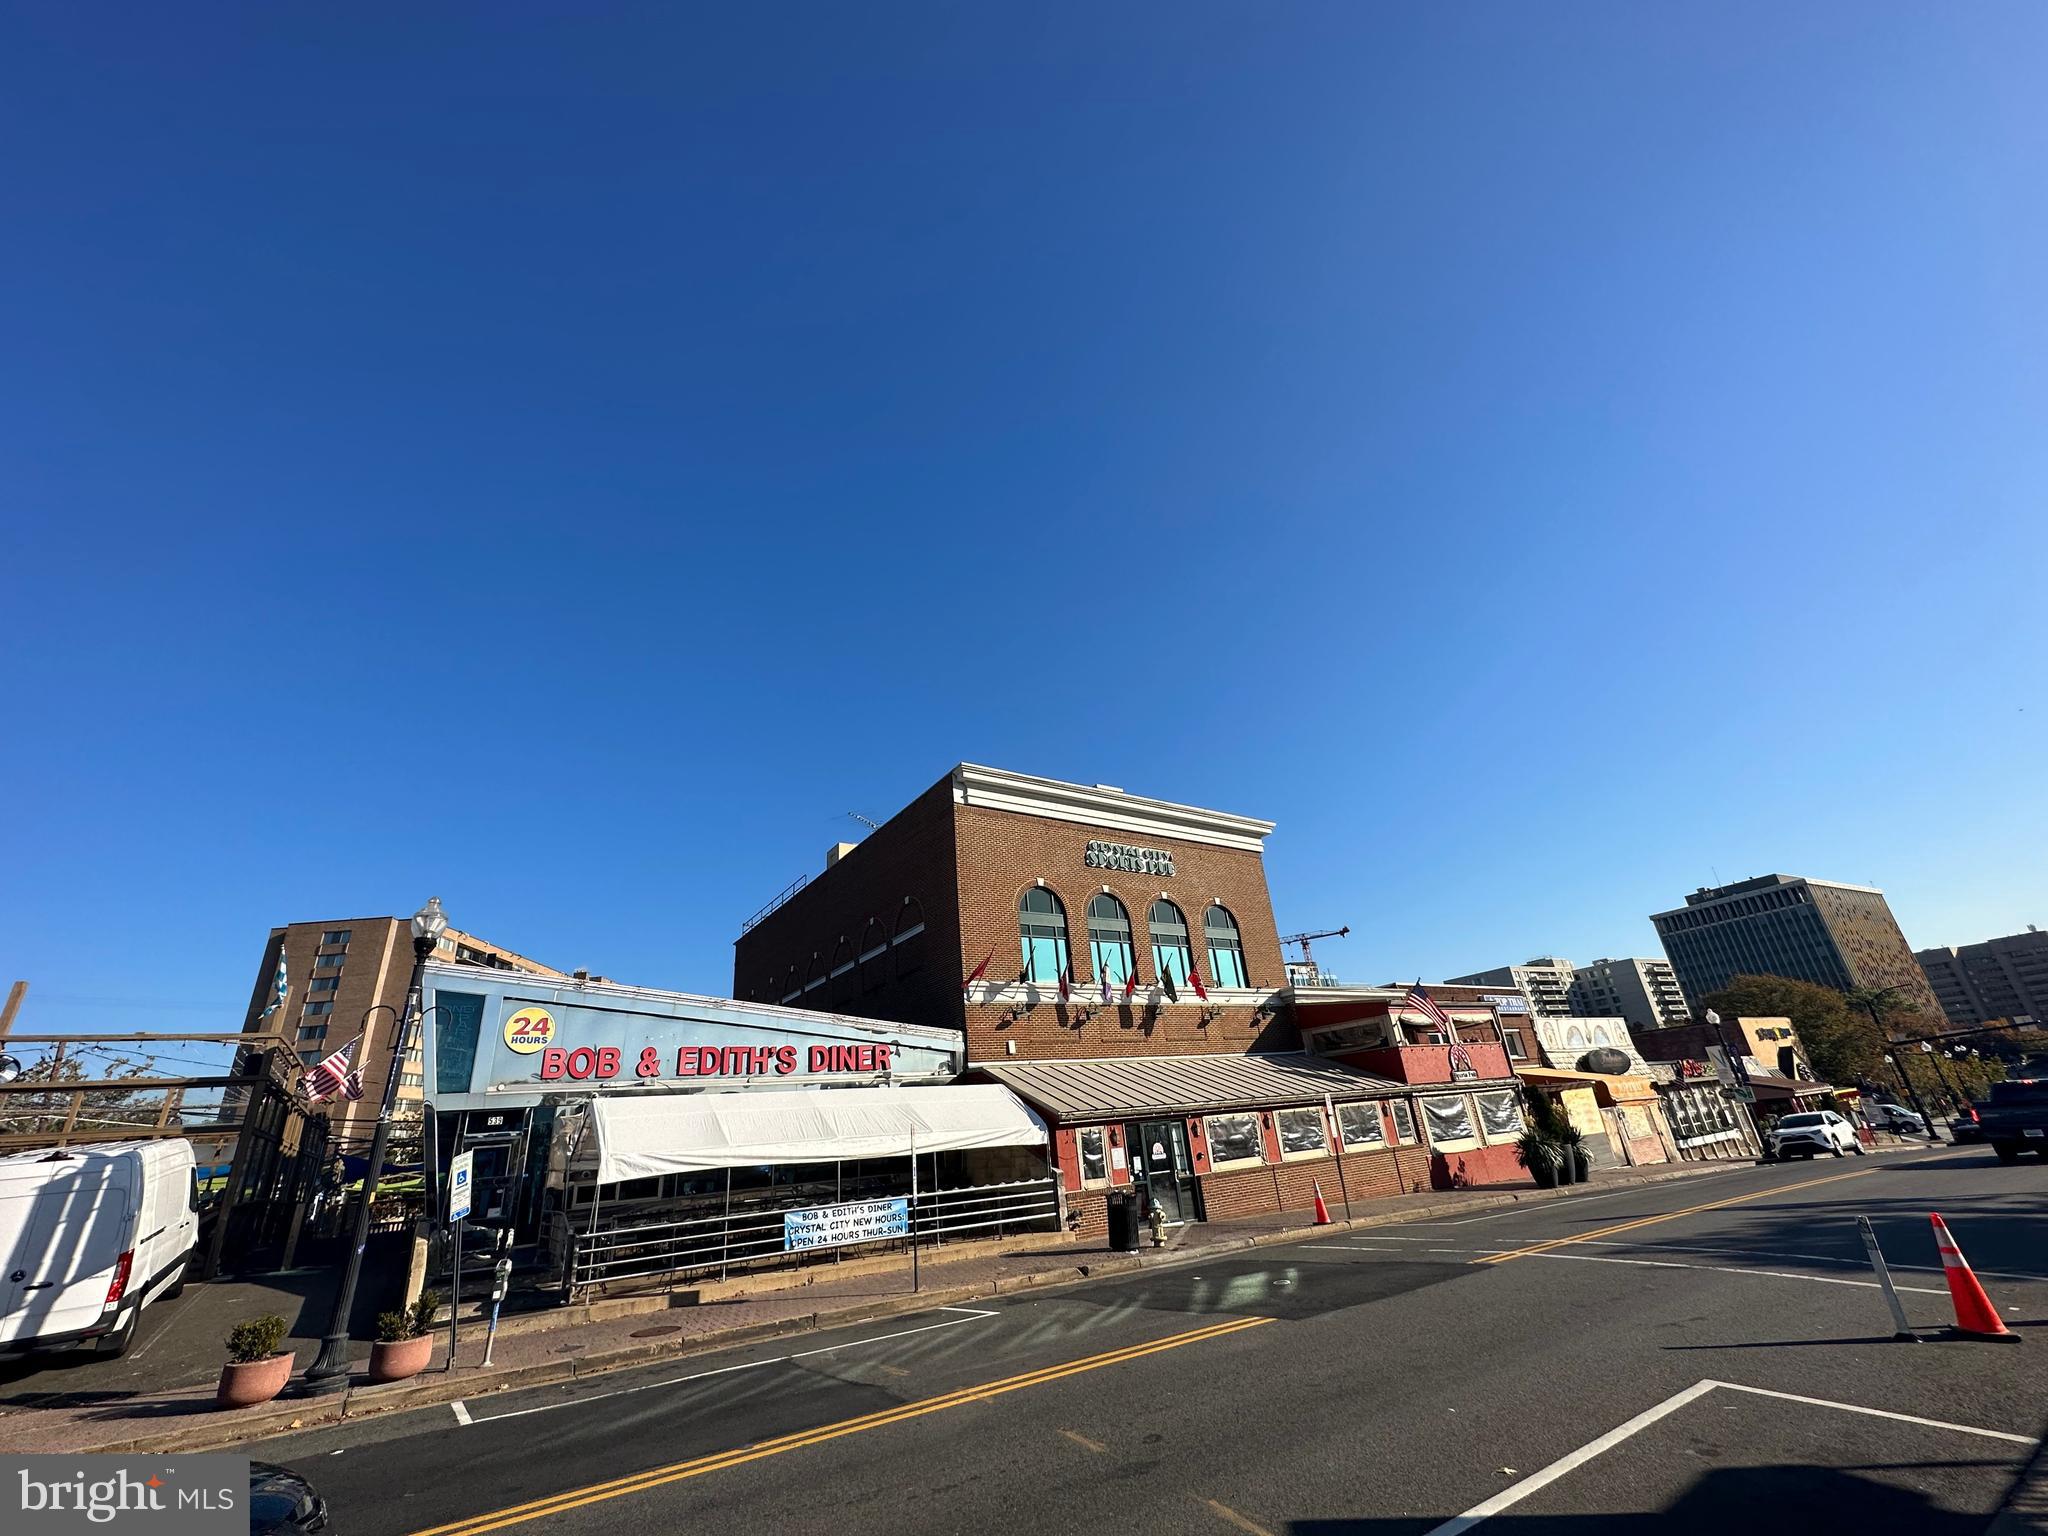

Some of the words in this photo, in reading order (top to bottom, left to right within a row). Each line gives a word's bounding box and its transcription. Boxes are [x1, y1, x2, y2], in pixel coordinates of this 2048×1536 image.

[1086, 851, 1145, 871] SPORTS
[1146, 859, 1176, 876] PUB
[512, 1017, 550, 1036] 24
[511, 1036, 548, 1044] HOURS
[541, 1047, 621, 1080] BOB
[636, 1046, 661, 1077] &
[676, 1045, 797, 1077] EDITH'S
[808, 1044, 892, 1072] DINER
[802, 1211, 818, 1222] BOB
[822, 1210, 829, 1218] &
[832, 1205, 865, 1218] EDITH'S
[867, 1202, 893, 1213] DINER
[788, 1223, 826, 1236] CRYSTAL
[829, 1219, 850, 1230] CITY
[853, 1216, 872, 1227] NEW
[791, 1236, 814, 1248] OPEN
[817, 1235, 828, 1244] 24
[831, 1230, 860, 1241] HOURS
[863, 1225, 903, 1238] THUR-SUN
